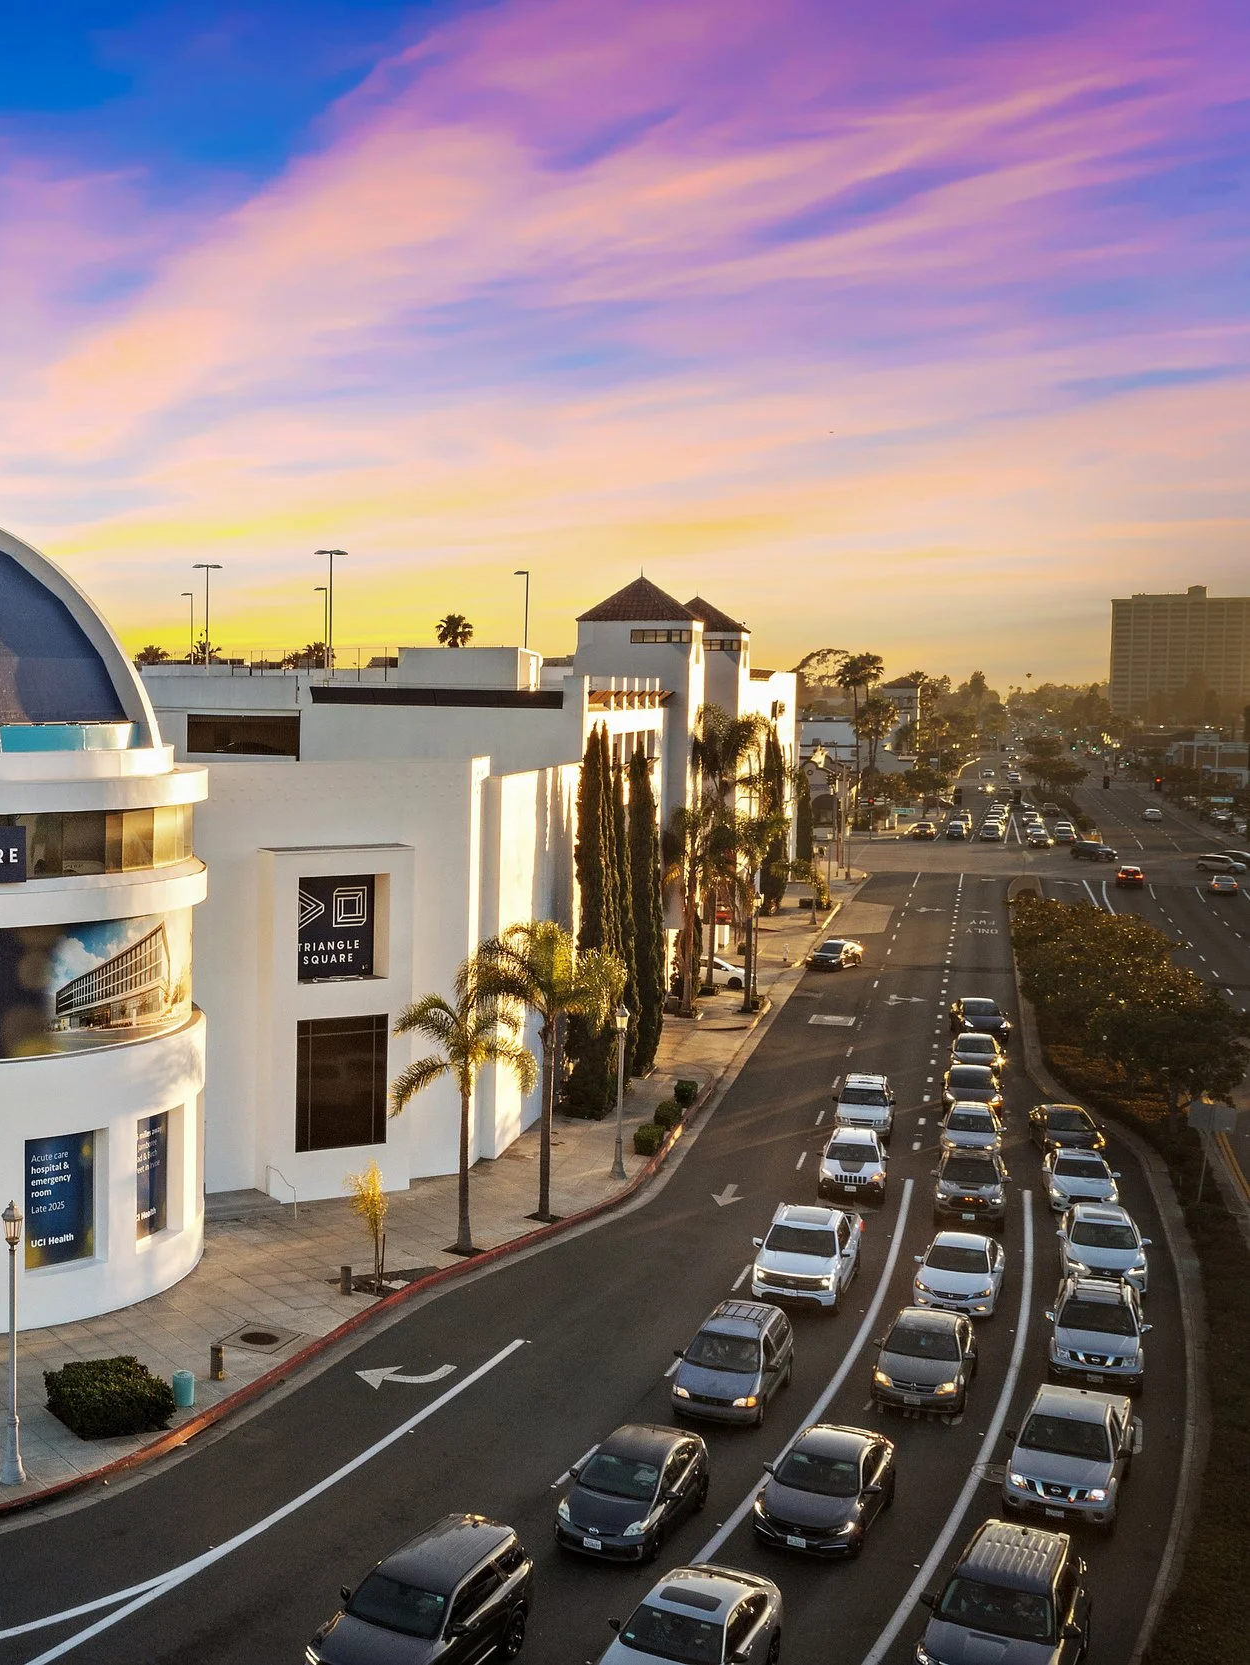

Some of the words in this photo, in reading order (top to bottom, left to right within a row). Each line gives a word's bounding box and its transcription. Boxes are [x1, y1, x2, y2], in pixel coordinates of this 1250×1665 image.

[298, 940, 360, 952] TRIANGLE
[303, 953, 353, 965] SQUARE
[31, 1153, 52, 1163] Acute
[53, 1151, 68, 1160] care
[31, 1162, 62, 1175] hospital
[63, 1162, 70, 1170] &
[31, 1173, 71, 1187] emergency
[31, 1188, 52, 1198] room
[31, 1203, 47, 1214] Late
[48, 1200, 65, 1212] 2025
[31, 1238, 45, 1248] UCI
[48, 1232, 74, 1246] Health
